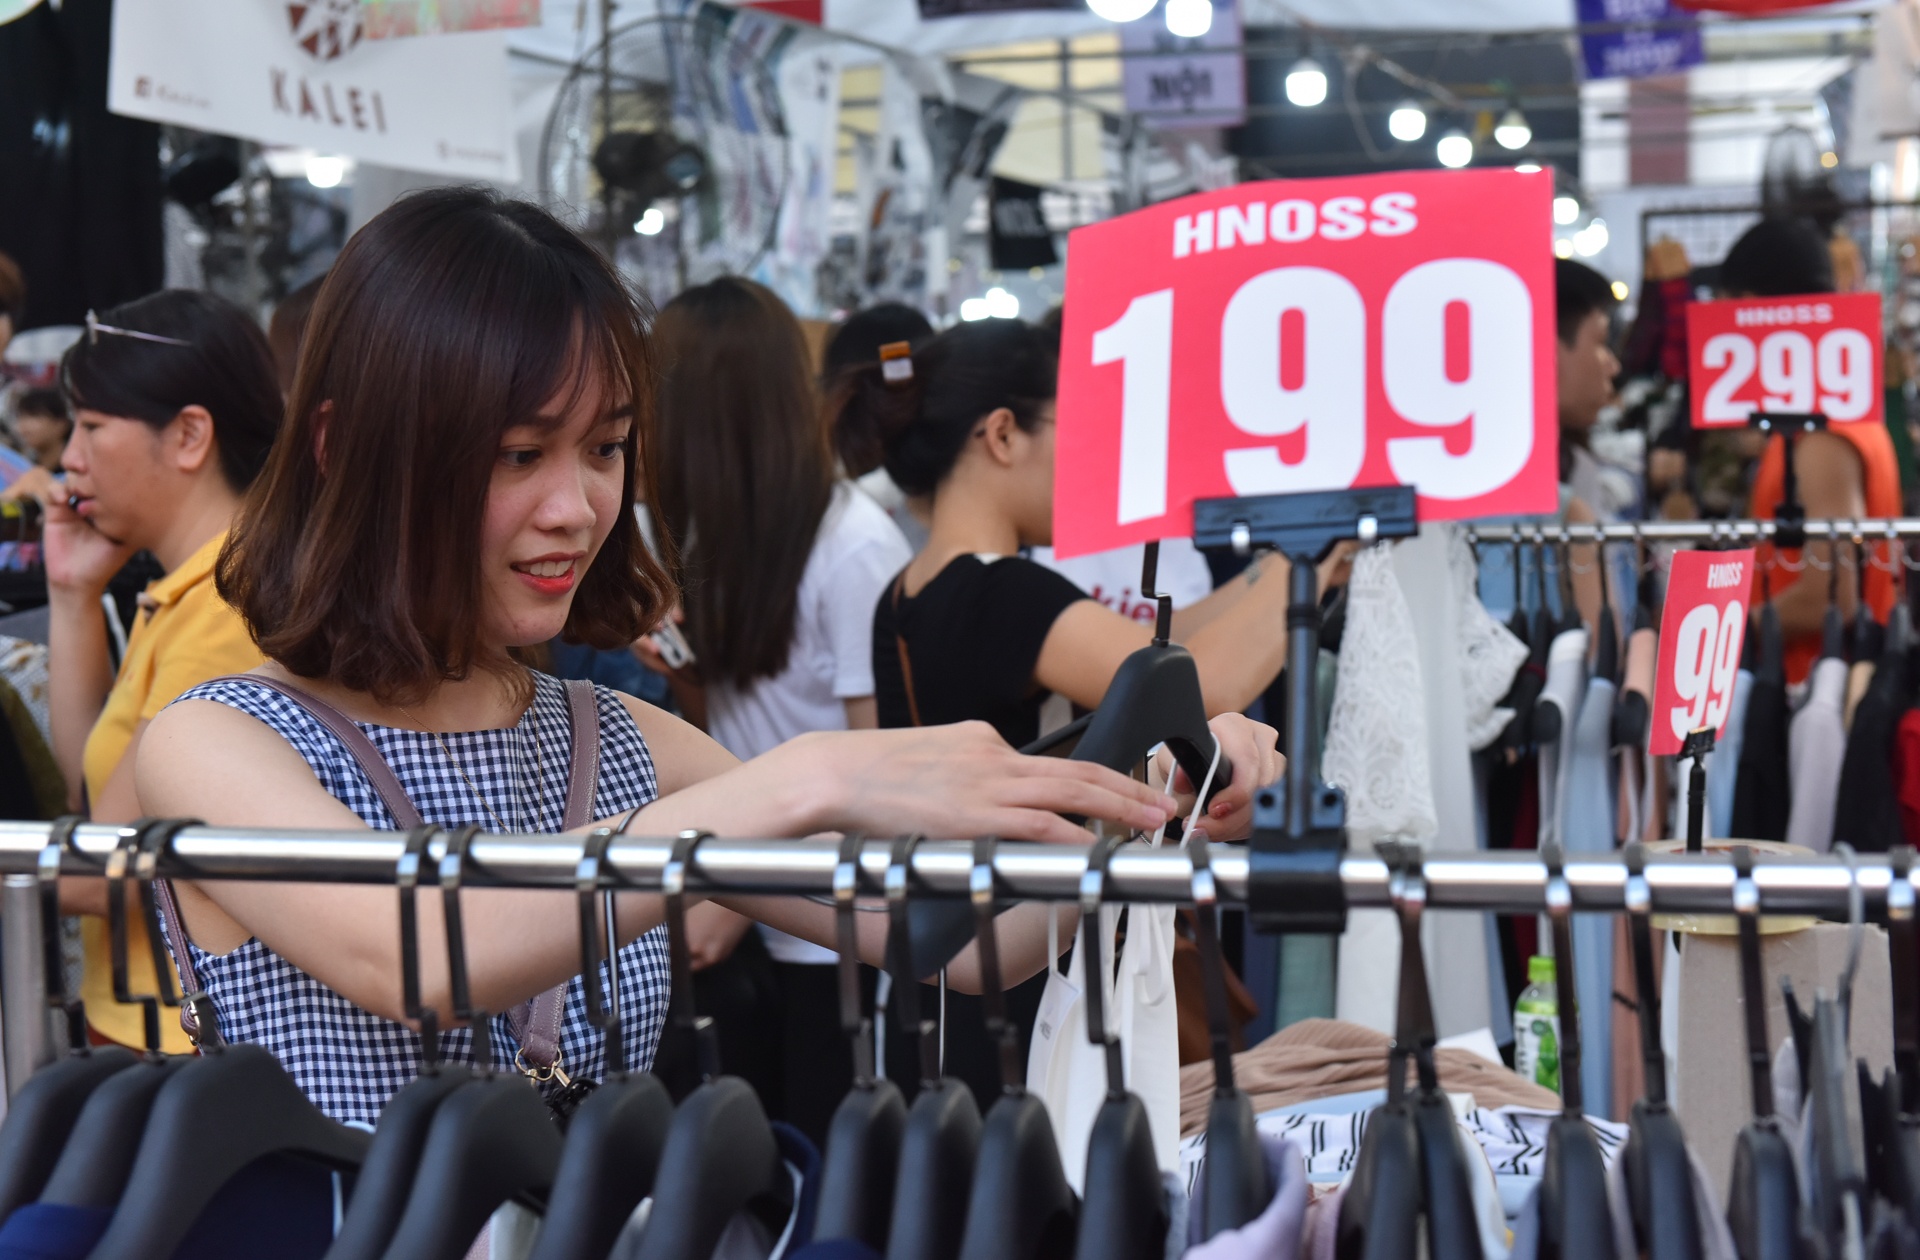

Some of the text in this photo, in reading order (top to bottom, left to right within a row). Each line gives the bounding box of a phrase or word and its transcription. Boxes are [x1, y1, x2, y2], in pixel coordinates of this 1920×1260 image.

[268, 65, 387, 134] KALEI
[1172, 191, 1419, 259] HNOSS
[1735, 303, 1833, 327] HNOSS
[1091, 257, 1535, 526] 199
[1702, 328, 1874, 424] 299
[1707, 561, 1744, 589] HNOSS
[1670, 599, 1744, 742] 99
